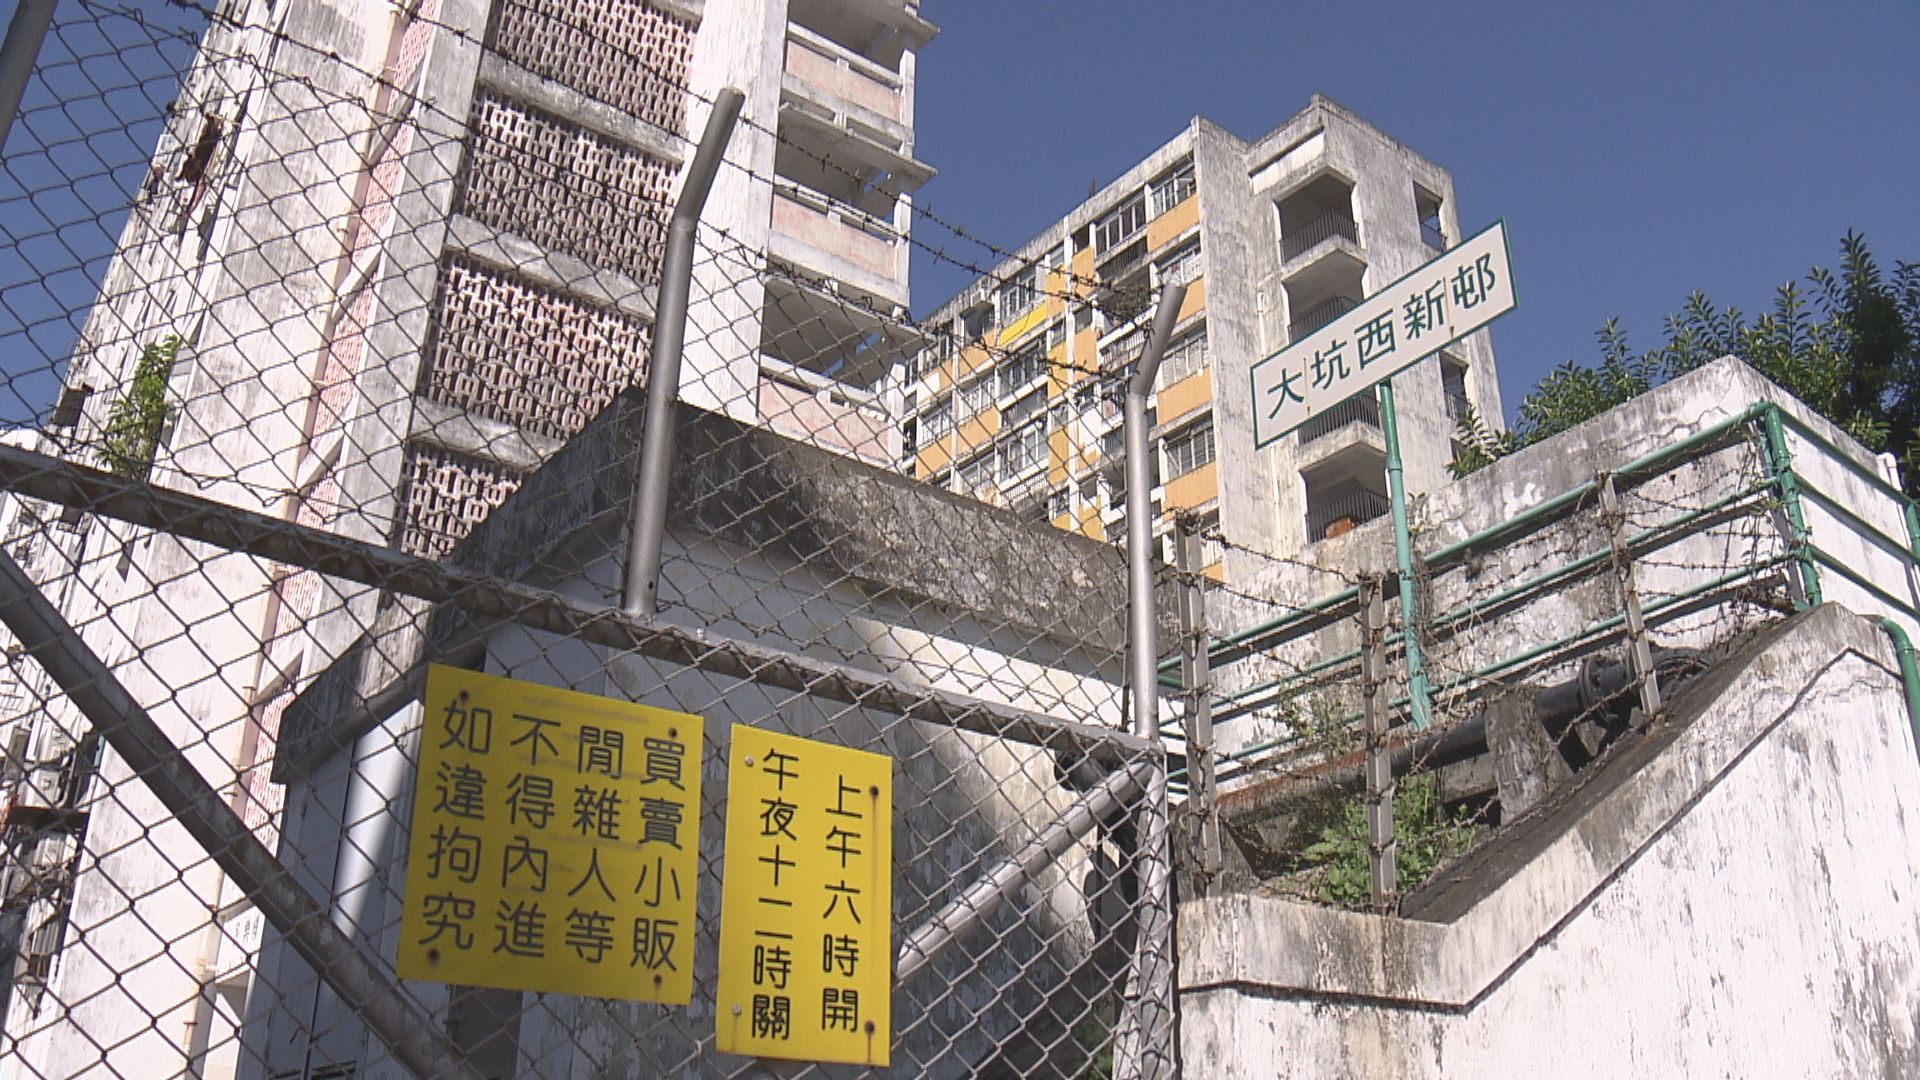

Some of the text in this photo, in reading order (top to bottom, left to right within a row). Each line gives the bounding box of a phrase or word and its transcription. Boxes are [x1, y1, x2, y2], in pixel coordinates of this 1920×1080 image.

[1267, 252, 1496, 421] 大坑西新邨
[419, 699, 493, 950] 如違拘究
[493, 713, 561, 958] 不得內進
[565, 725, 625, 964] 閒雜人等
[630, 737, 686, 972] 買賣小販
[752, 748, 799, 1040] 午夜十二時關
[821, 774, 863, 1033] 上午六時開
